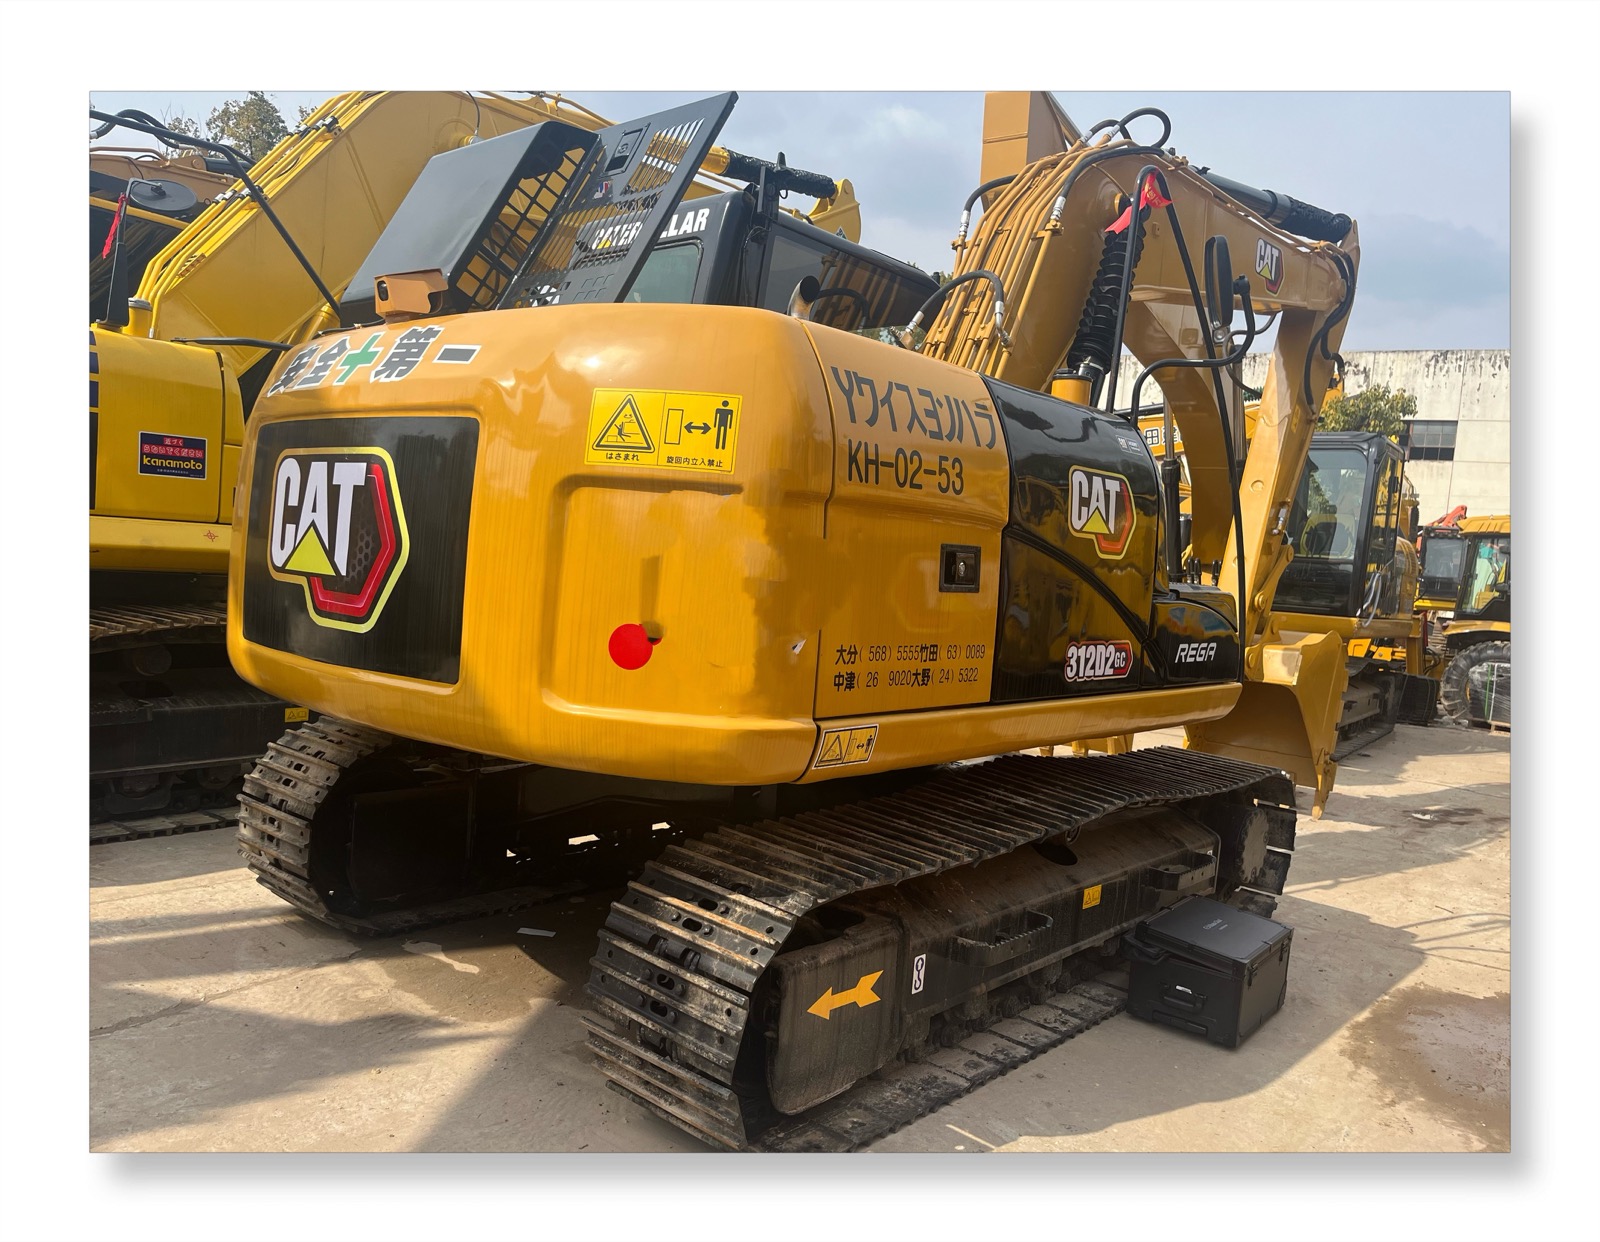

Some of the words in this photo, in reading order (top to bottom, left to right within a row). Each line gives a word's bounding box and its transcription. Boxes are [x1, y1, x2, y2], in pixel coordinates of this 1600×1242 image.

[1256, 238, 1279, 281] CAT
[143, 455, 203, 470] kanamoto
[606, 452, 639, 462] はさまれ
[666, 456, 723, 468] 旋回内立入禁止
[848, 439, 964, 496] KH-02-53
[271, 458, 367, 576] CAT
[1072, 470, 1121, 534] CAT
[1066, 645, 1115, 678] 312D2
[1175, 643, 1217, 663] REGA
